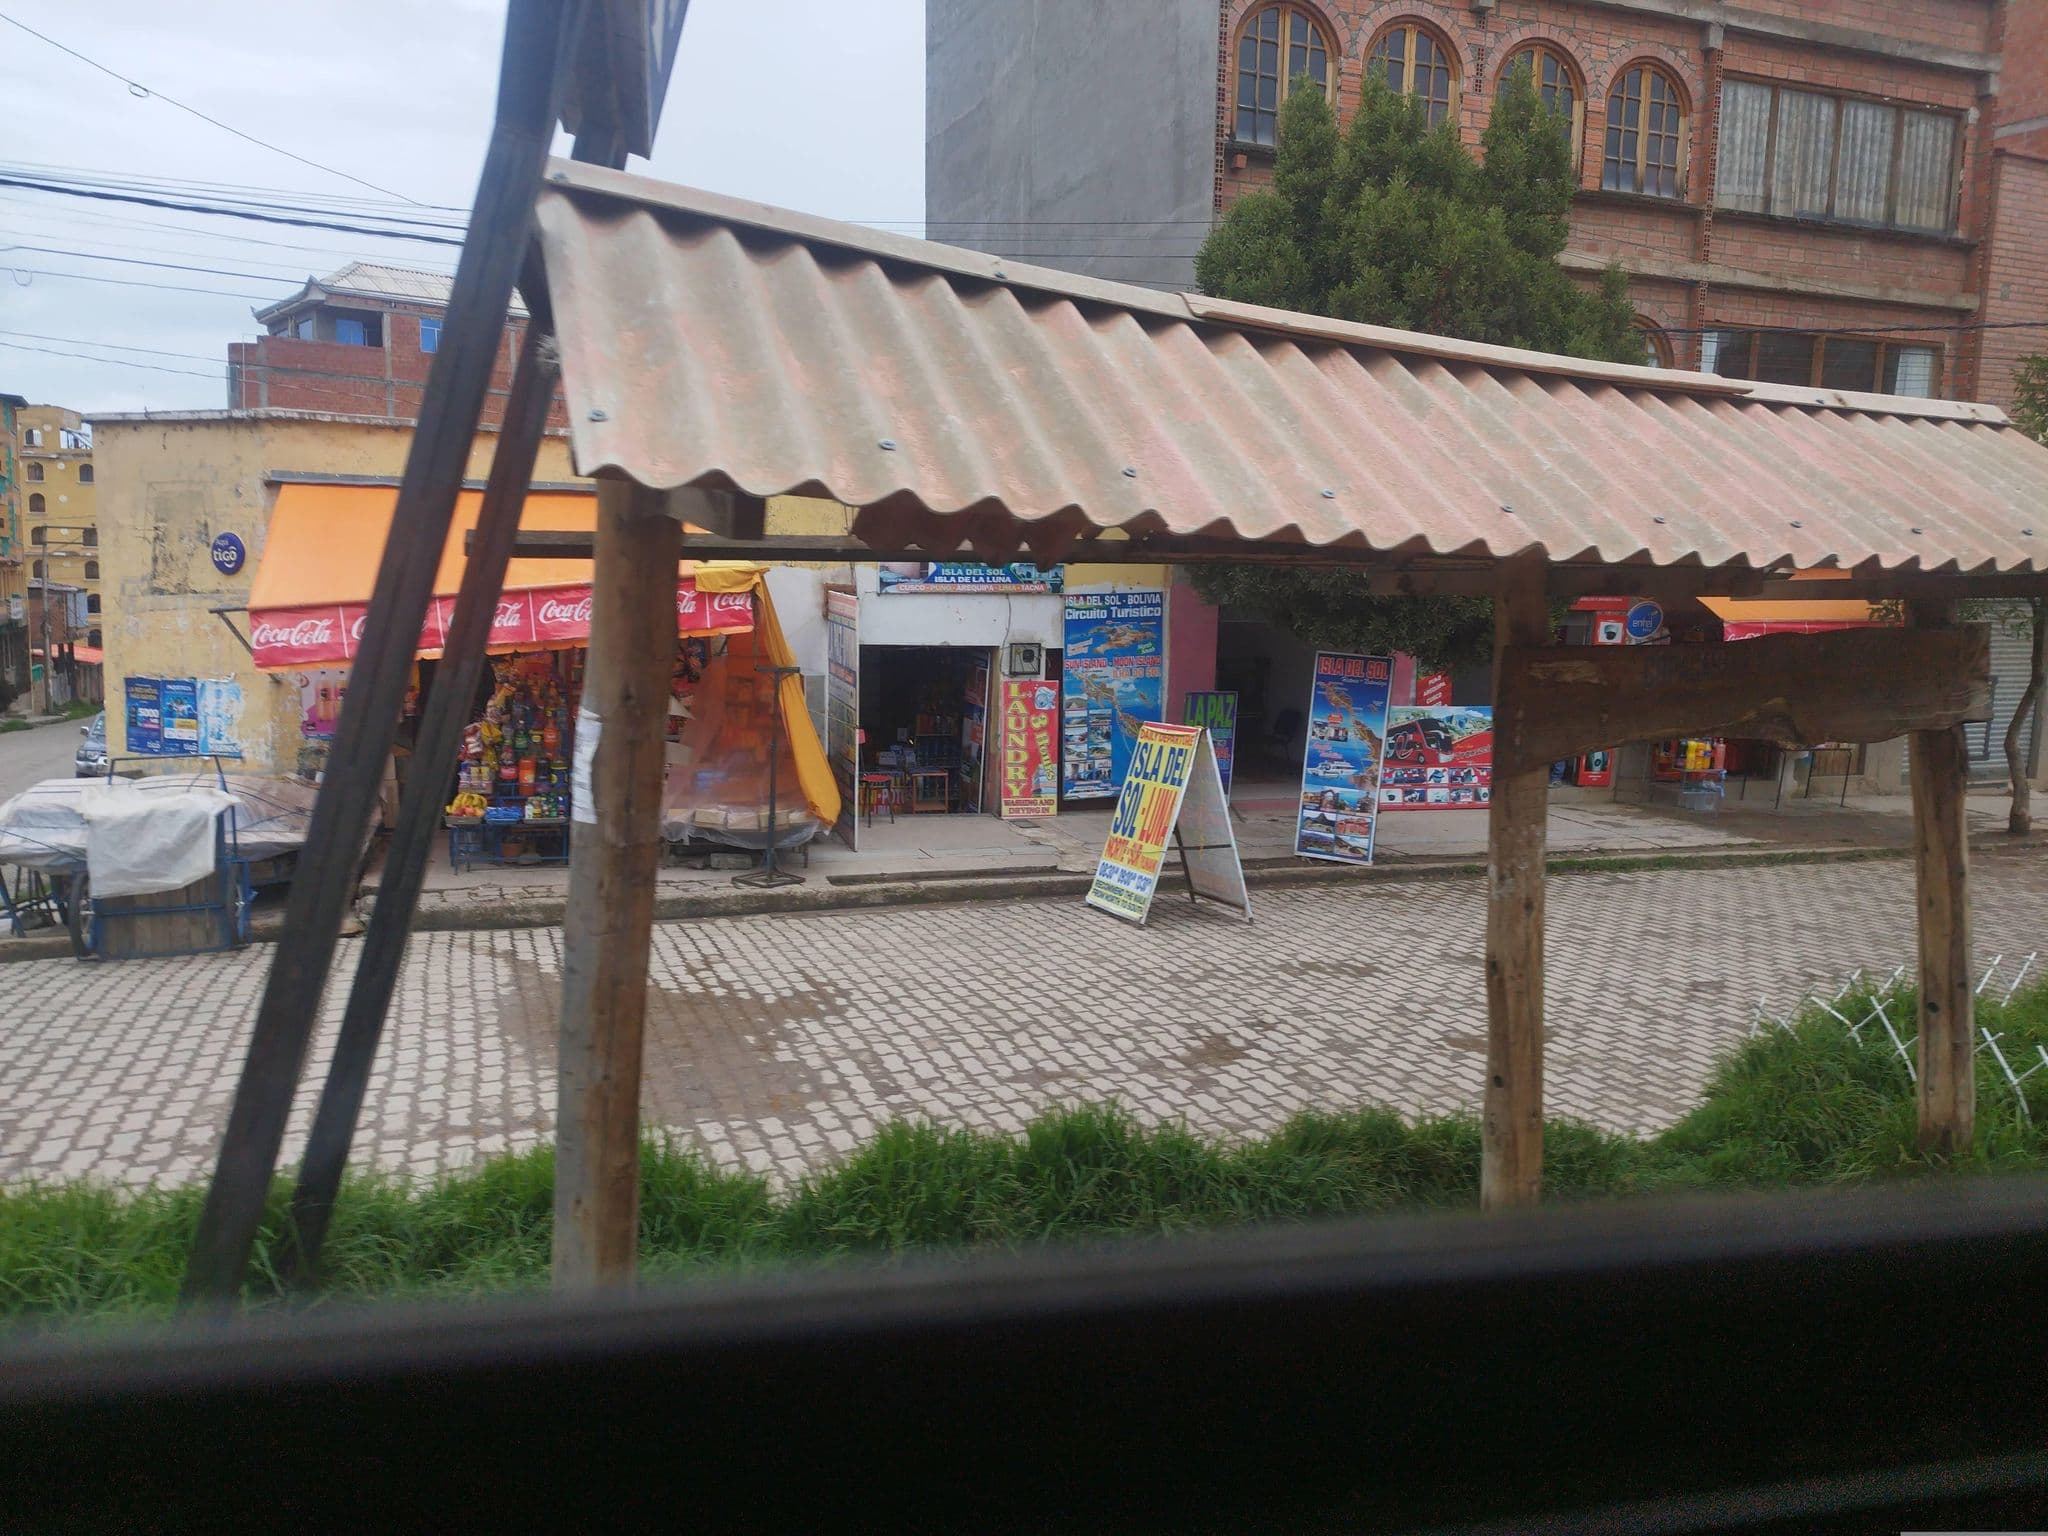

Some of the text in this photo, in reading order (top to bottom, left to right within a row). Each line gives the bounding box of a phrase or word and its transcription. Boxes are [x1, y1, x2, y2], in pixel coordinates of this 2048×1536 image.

[213, 546, 237, 568] tigo
[942, 568, 1006, 576] ISLA DEL SOL
[899, 584, 926, 592] CUSCO
[956, 584, 994, 592] AREQUIPA
[1020, 584, 1045, 592] TACNA
[1065, 594, 1085, 607] ISLA
[1086, 594, 1103, 606] DEL
[1104, 594, 1121, 606] SOL
[1127, 593, 1161, 605] BOLIVIA
[1065, 607, 1108, 620] Circuito
[1632, 616, 1653, 628] entel
[1319, 656, 1388, 679] ISLA DEL SOL
[1206, 694, 1234, 729] PAZ
[1006, 683, 1029, 798] LAUNDRY
[1129, 741, 1188, 787] ISLA DEL
[1113, 780, 1146, 839] SOL
